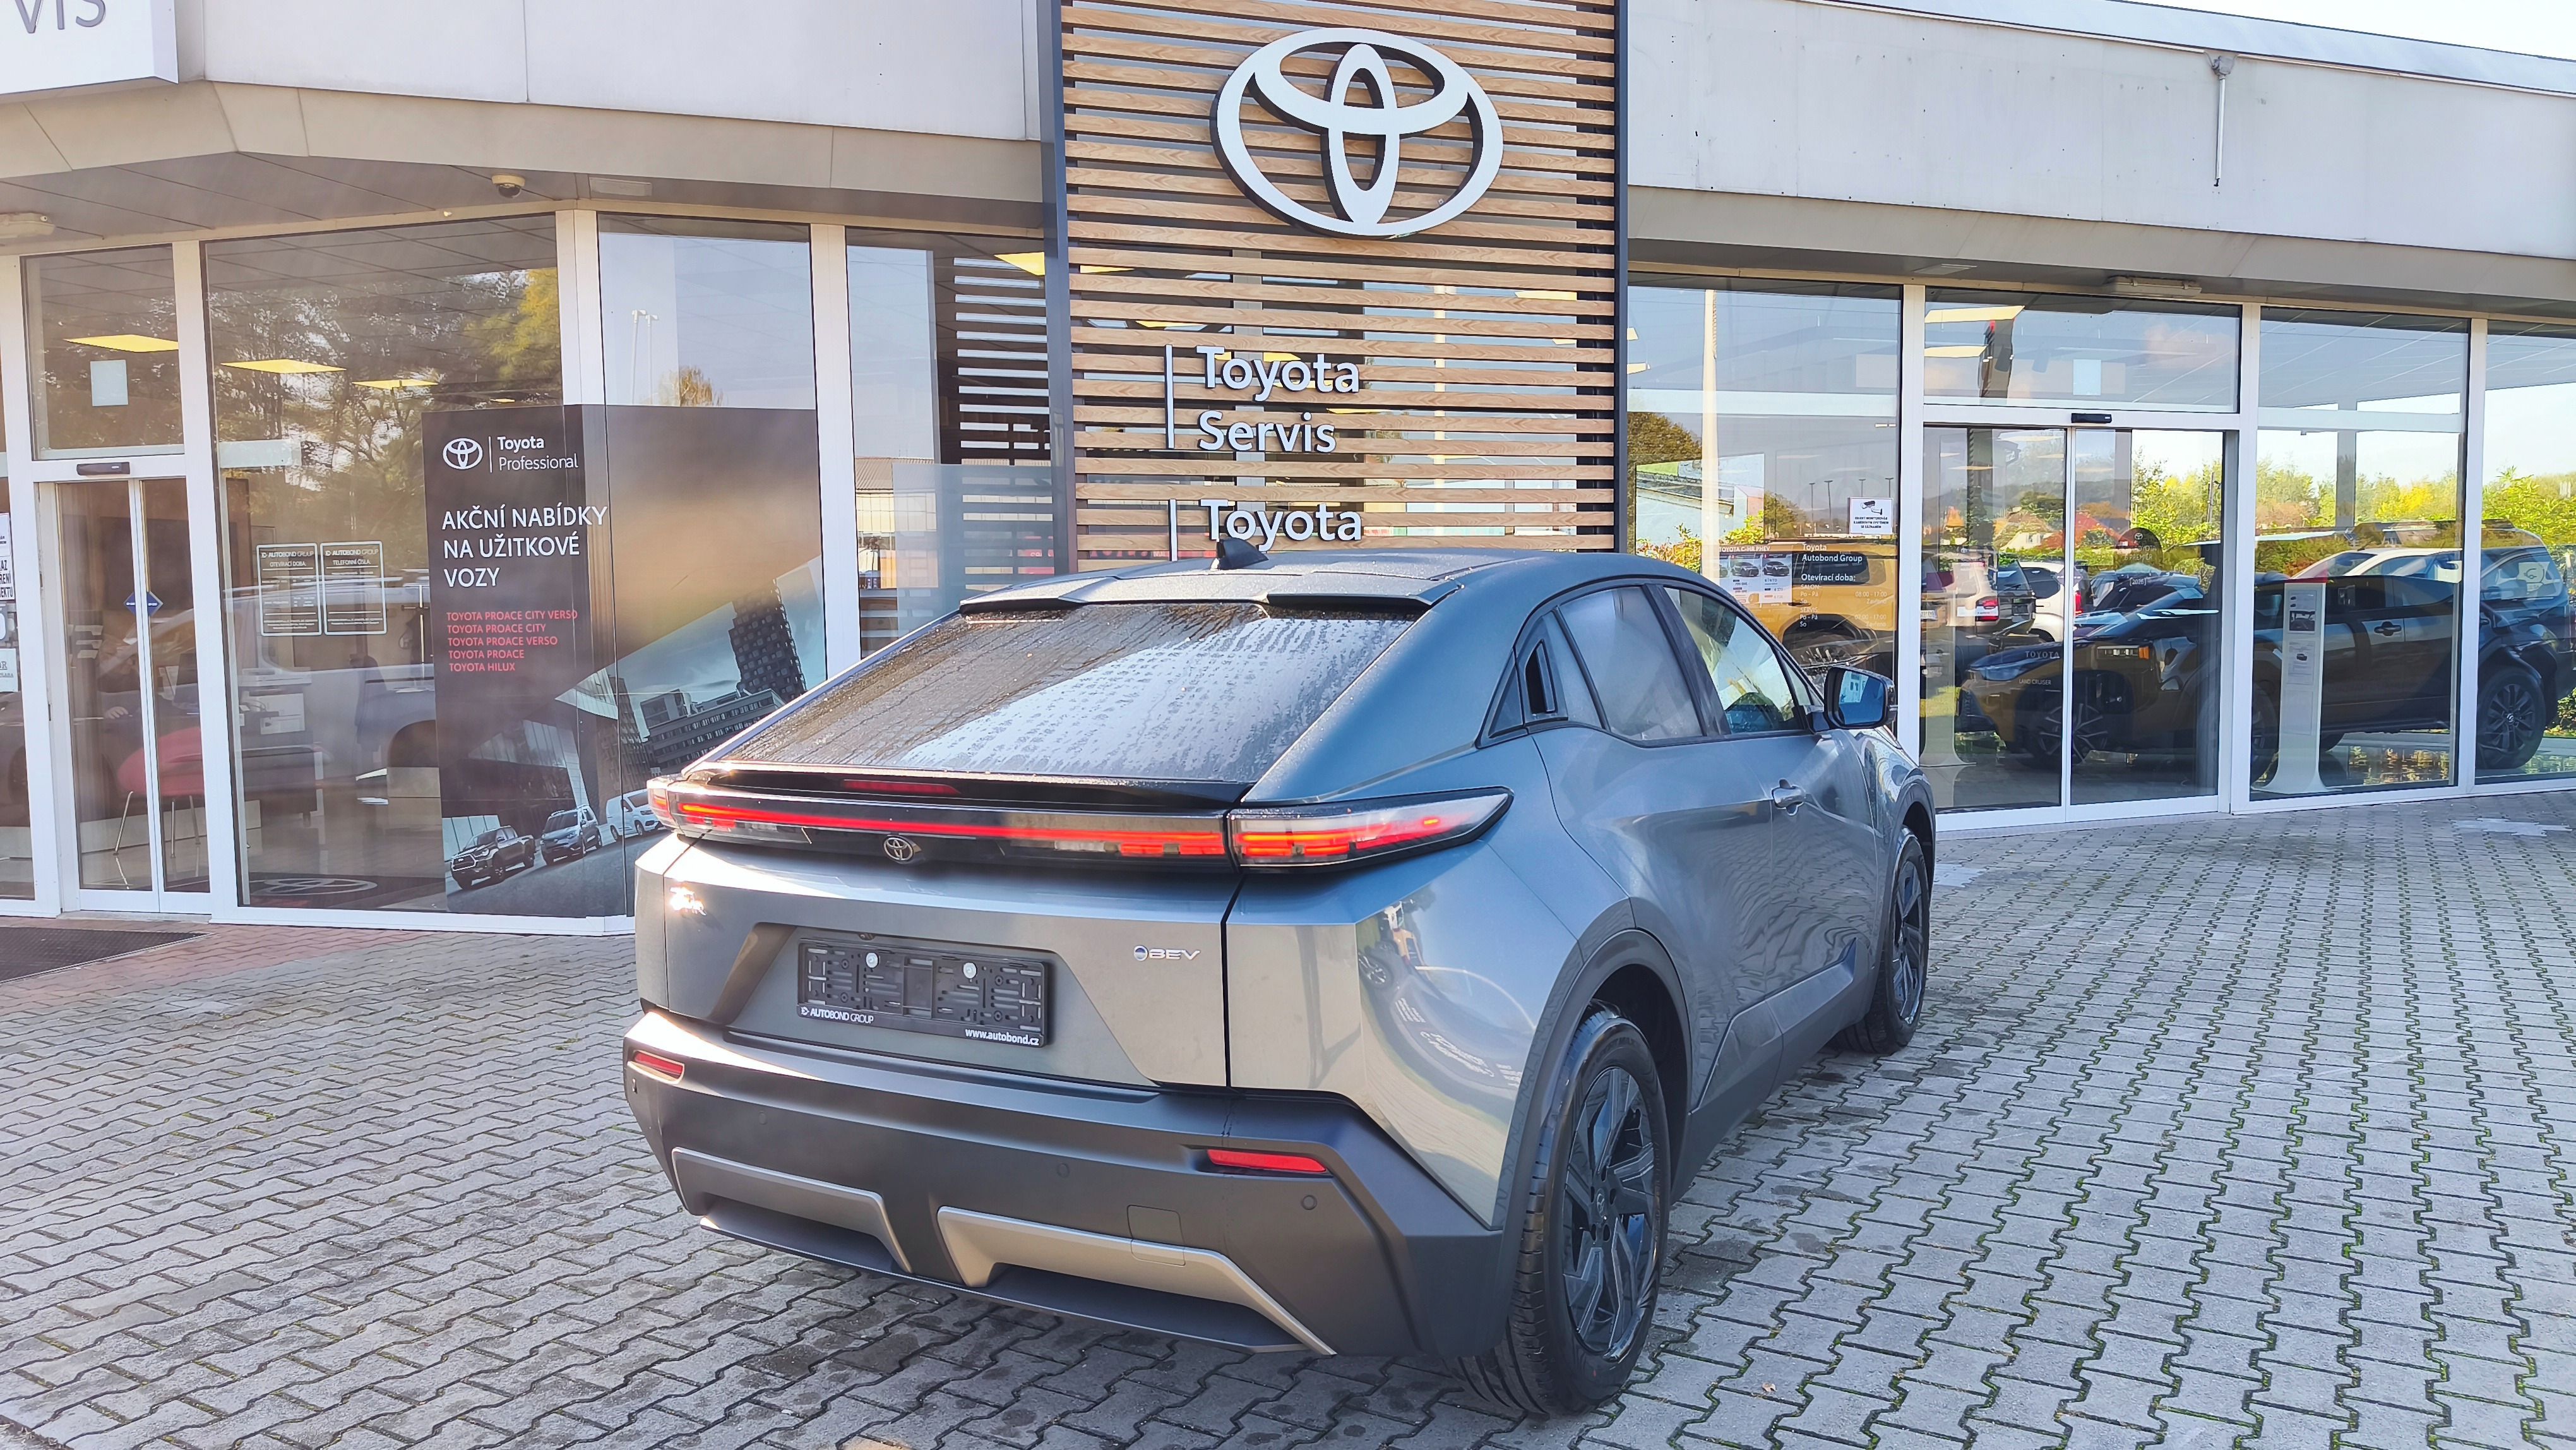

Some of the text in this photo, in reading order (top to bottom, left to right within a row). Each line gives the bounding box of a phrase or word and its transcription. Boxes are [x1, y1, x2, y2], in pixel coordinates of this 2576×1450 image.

[1196, 345, 1359, 402] Toyota
[1198, 410, 1337, 453] Servis
[498, 436, 544, 453] Toyota
[499, 453, 578, 471] Professional
[442, 502, 607, 530] AKČNÍ NABÍDKY
[1199, 499, 1362, 552] Toyota
[444, 530, 580, 559] NA UŽITKOVÉ
[1803, 544, 1827, 552] Toyota
[1840, 554, 1863, 563] Group
[444, 567, 500, 587] VOZY
[1801, 573, 1834, 581] Otevírací
[446, 610, 578, 621] TOYOTA PROACE CITY VERSO
[447, 623, 546, 634] TOYOTA PROACE CITY
[448, 636, 558, 647] TOYOTA PROACE VERSO
[448, 650, 525, 659] TOYOTA PROACE
[2025, 650, 2060, 659] TOYOTA
[449, 662, 516, 672] TOYOTA HILUX
[1149, 949, 1200, 960] BEV
[810, 1008, 874, 1024] AUTOBOND GROUP
[965, 1029, 1039, 1046] www.autobond.cz
